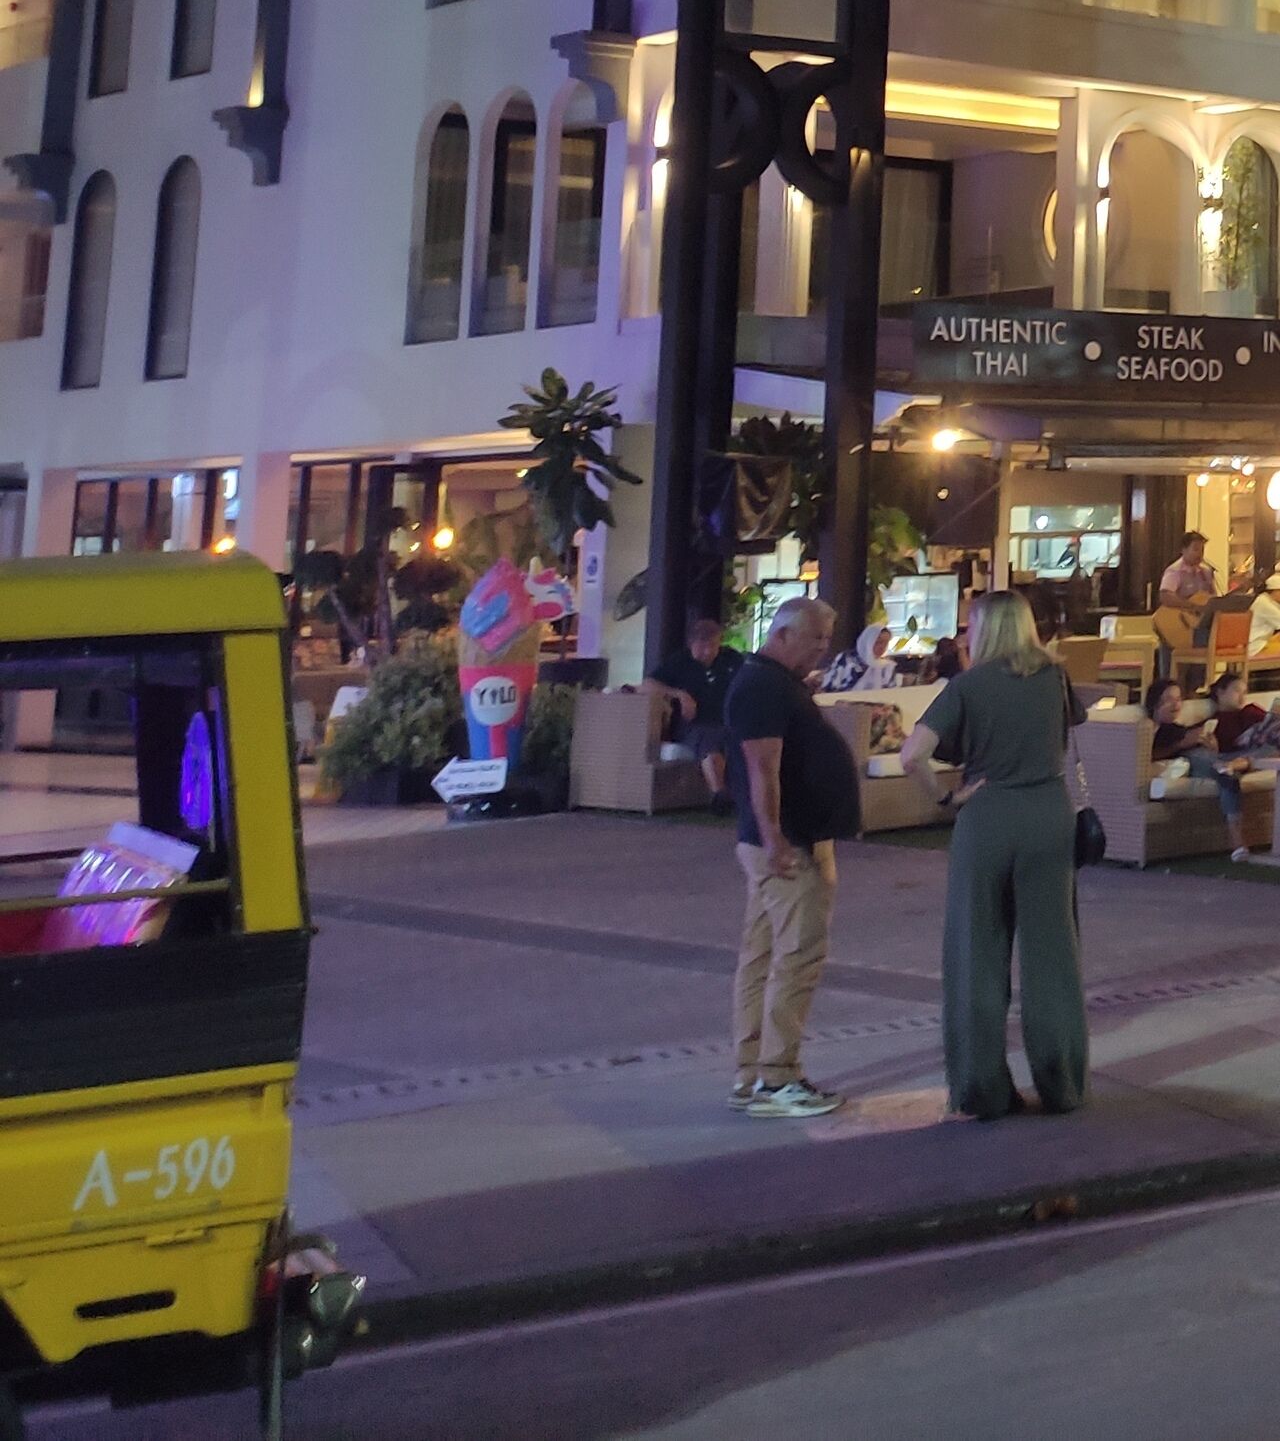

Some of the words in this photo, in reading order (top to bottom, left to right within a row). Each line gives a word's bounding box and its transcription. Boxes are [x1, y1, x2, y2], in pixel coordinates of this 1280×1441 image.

[930, 316, 1068, 345] AUTHENTIC
[1136, 325, 1205, 351] STEAK
[972, 351, 1028, 377] THAI
[1116, 355, 1224, 382] SEAFOOD
[73, 1135, 236, 1212] A-596
